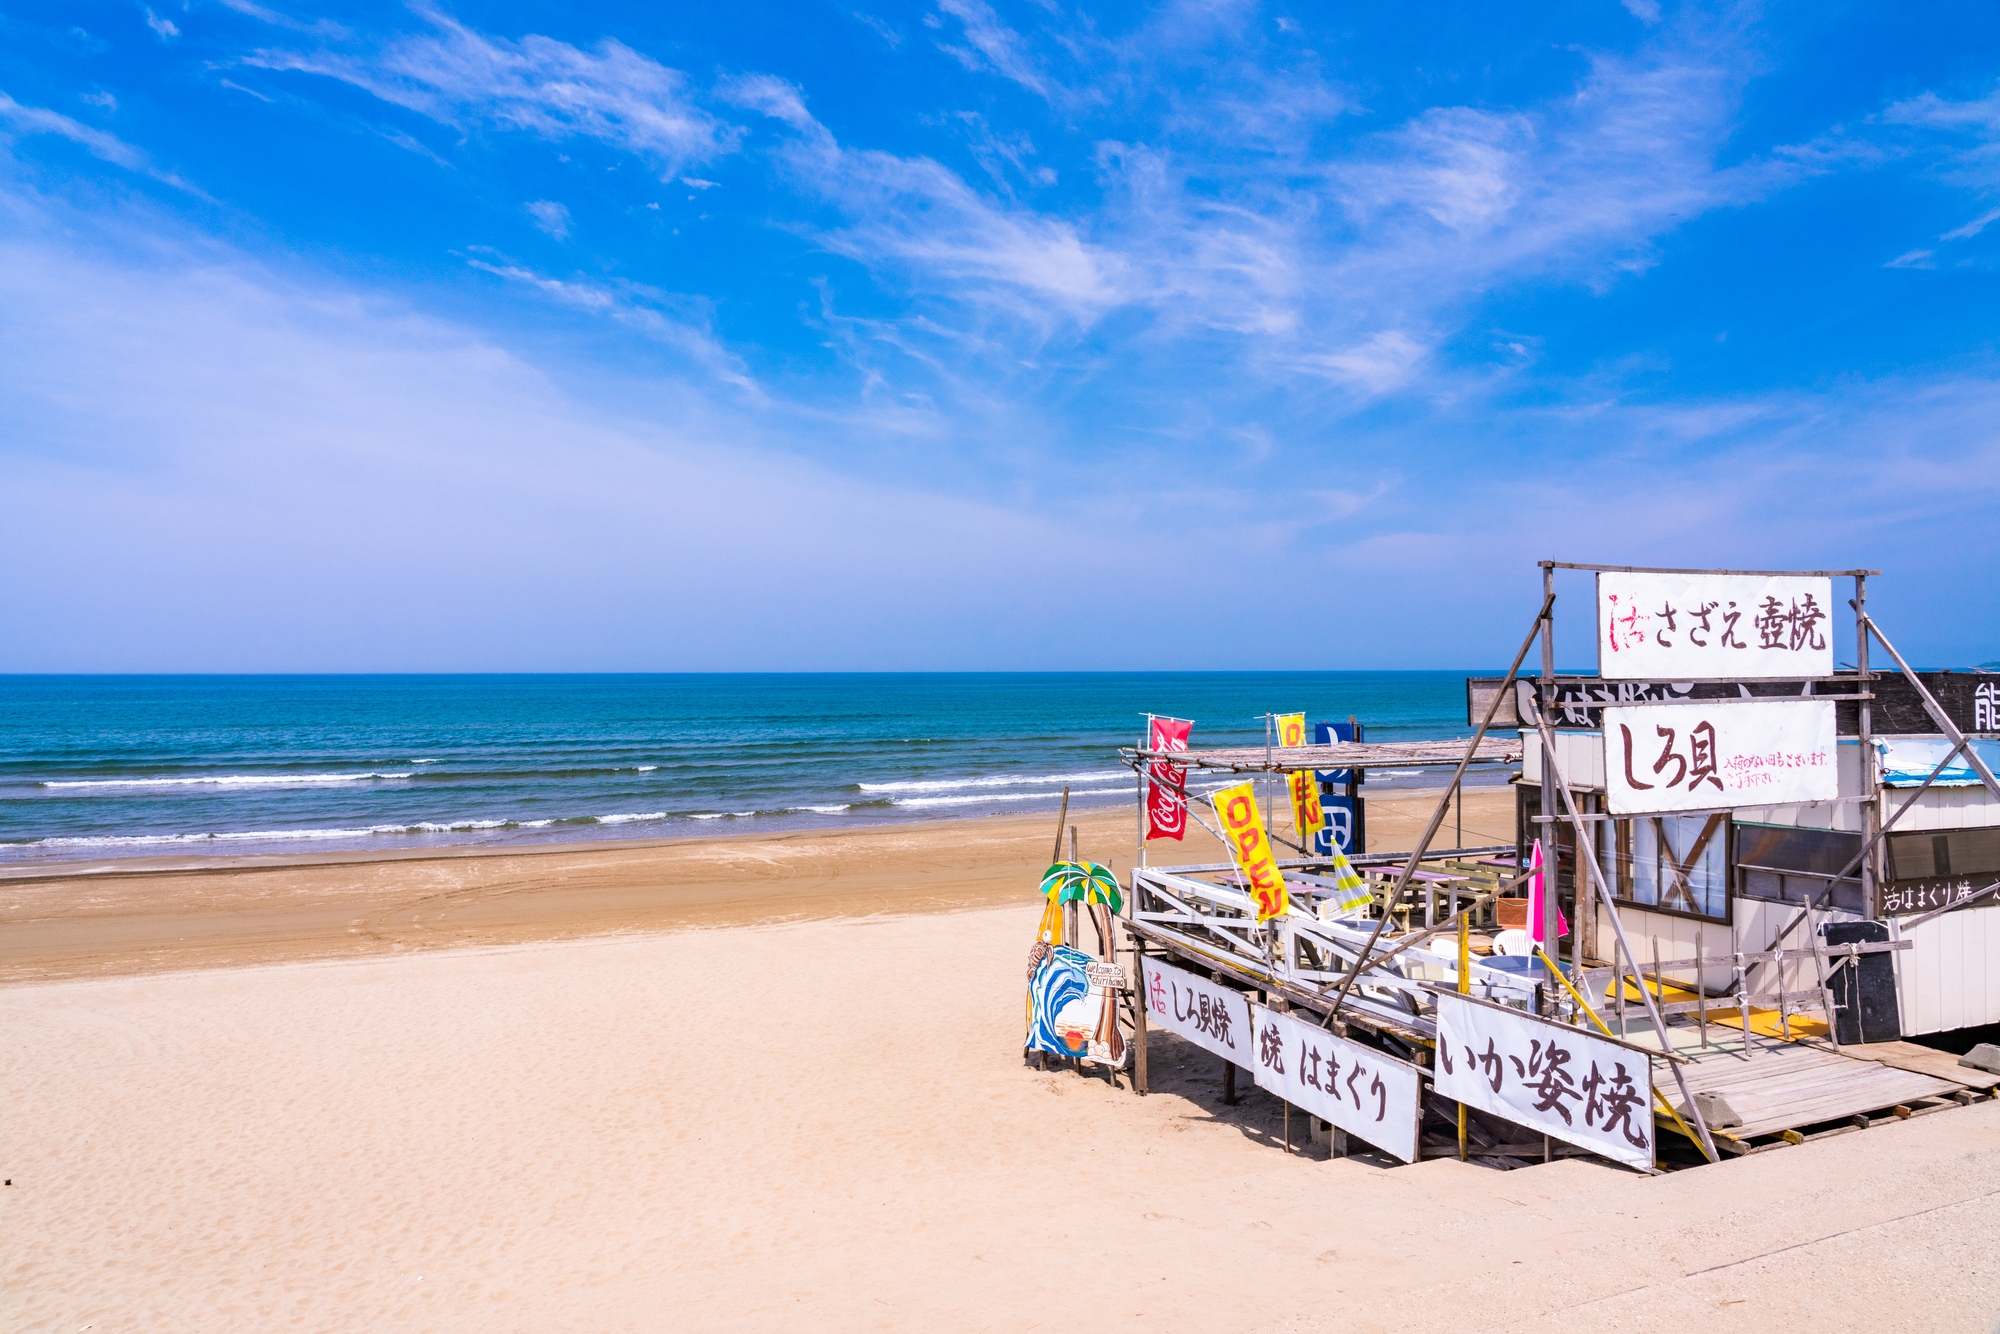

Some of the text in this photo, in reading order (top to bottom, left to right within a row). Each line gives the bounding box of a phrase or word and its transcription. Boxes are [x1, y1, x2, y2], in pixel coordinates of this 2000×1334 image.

[1151, 729, 1186, 833] CocaCla
[1285, 723, 1320, 829] OEN
[1620, 720, 1724, 792] しろ貝
[1226, 796, 1283, 916] OPEN
[1439, 1031, 1650, 1150] いか姿焼
